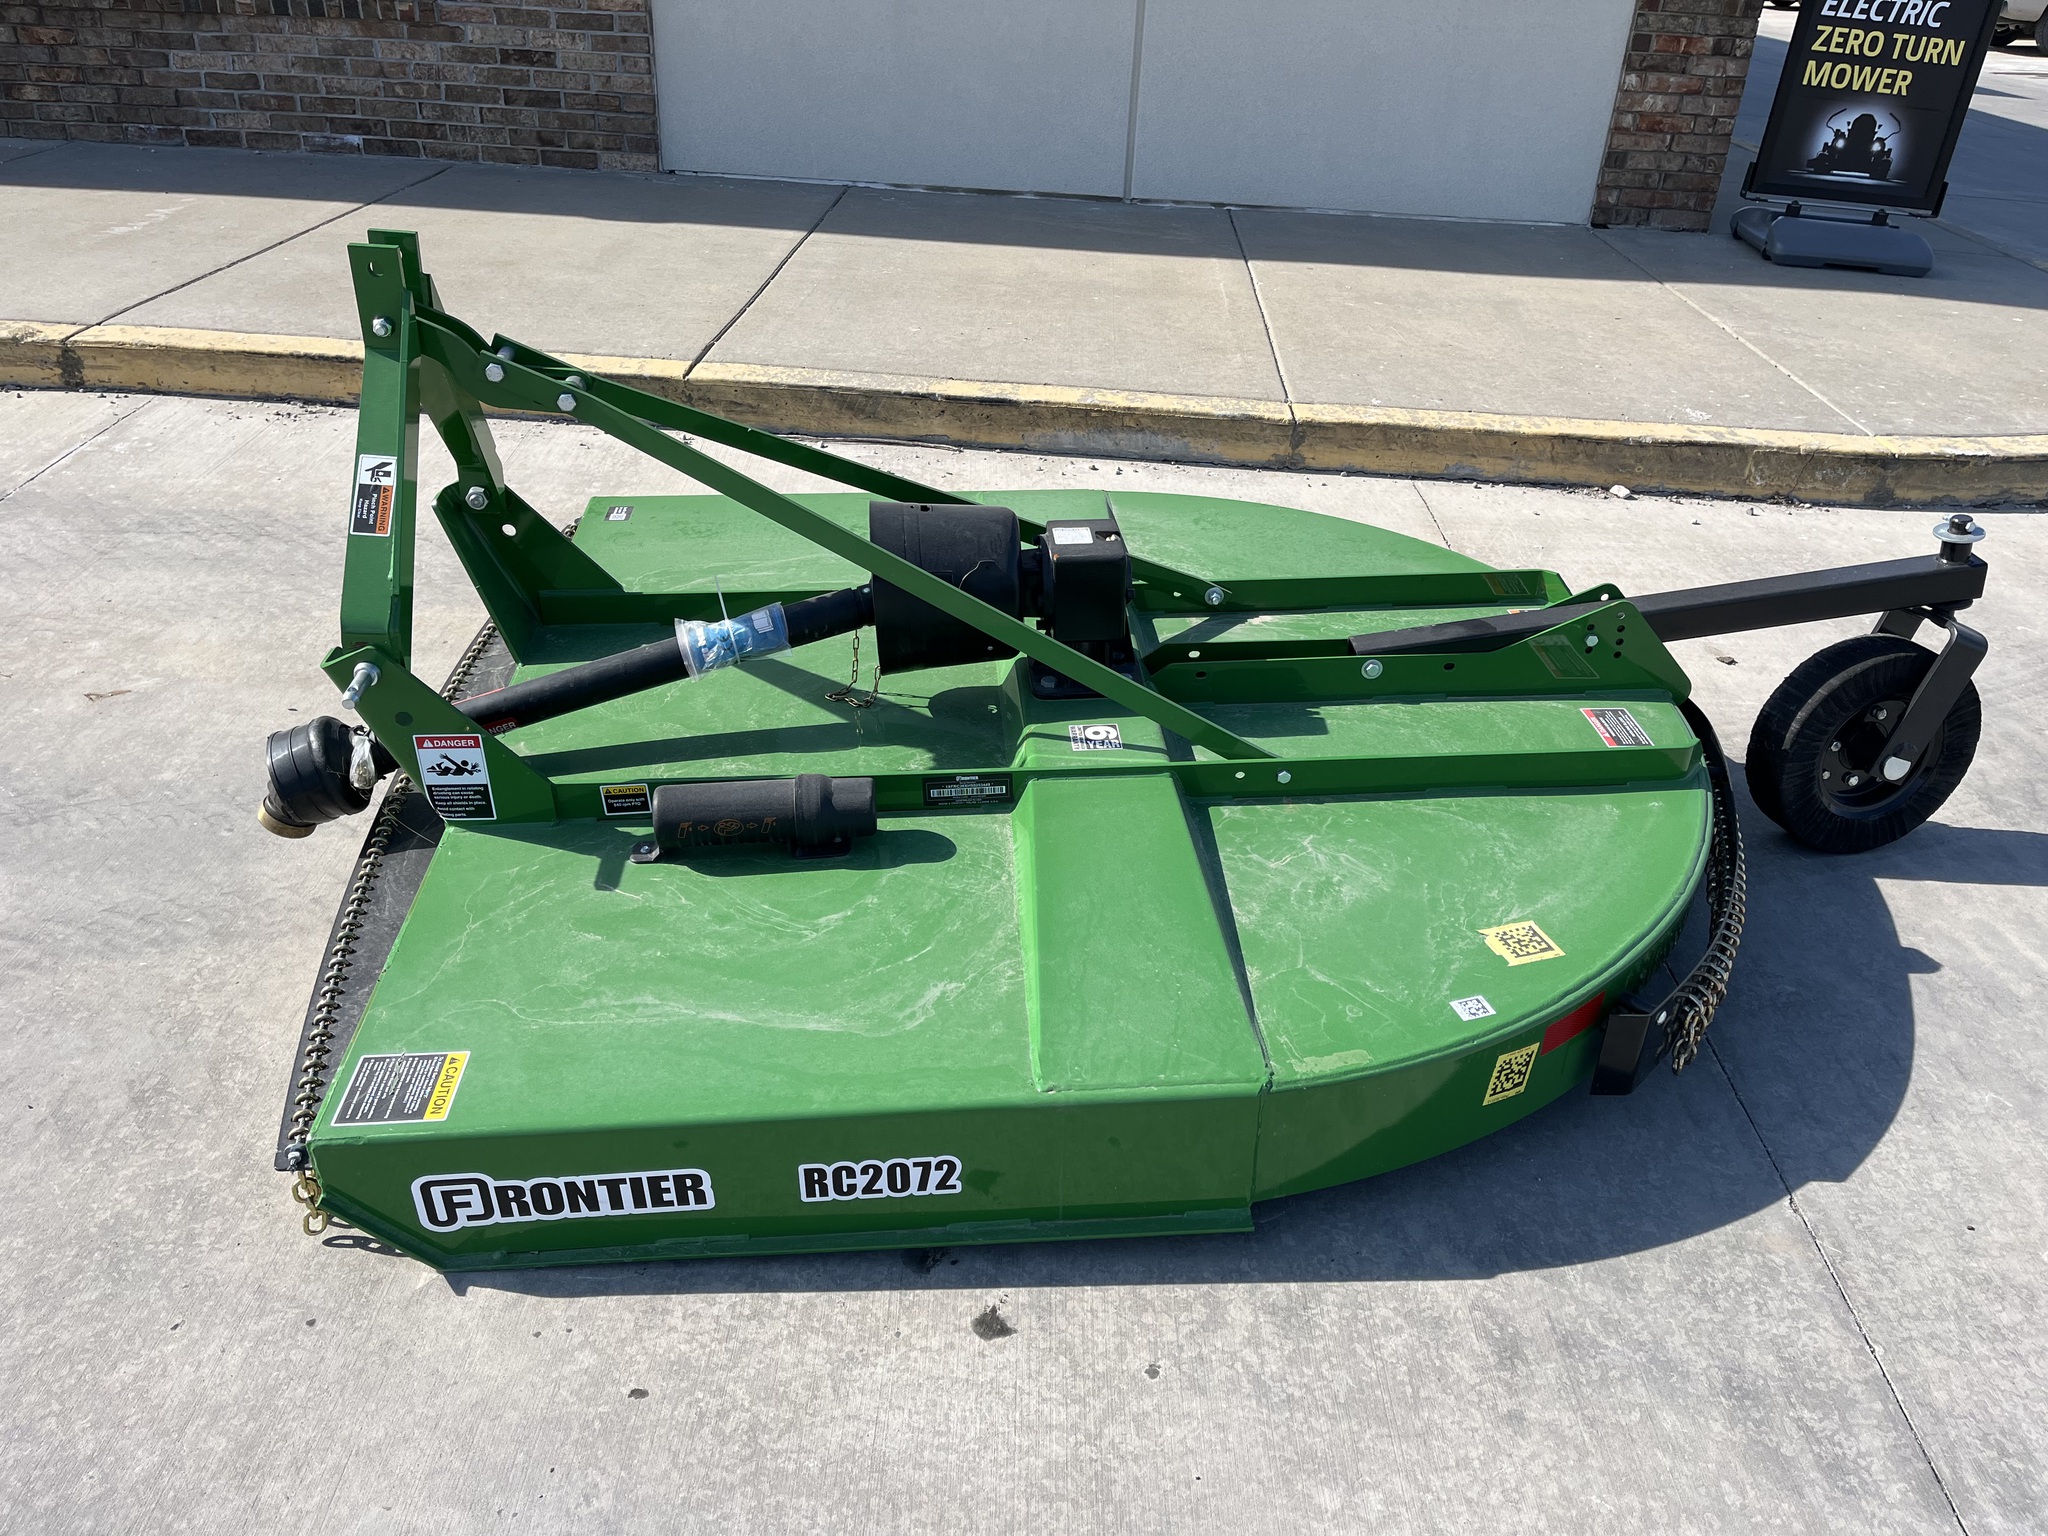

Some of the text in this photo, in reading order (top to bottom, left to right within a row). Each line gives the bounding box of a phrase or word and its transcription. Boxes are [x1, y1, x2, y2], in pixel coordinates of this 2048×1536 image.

[1820, 0, 1950, 28] ELECTRIC
[1811, 25, 1965, 66] ZERO TURN
[1802, 60, 1912, 96] MOWER
[378, 494, 390, 532] WARNING
[488, 721, 516, 734] NGER
[1087, 740, 1120, 749] YEAR
[430, 1066, 458, 1115] CAUTION
[803, 1159, 961, 1199] RC2072
[417, 1172, 711, 1228] FRONTIER
